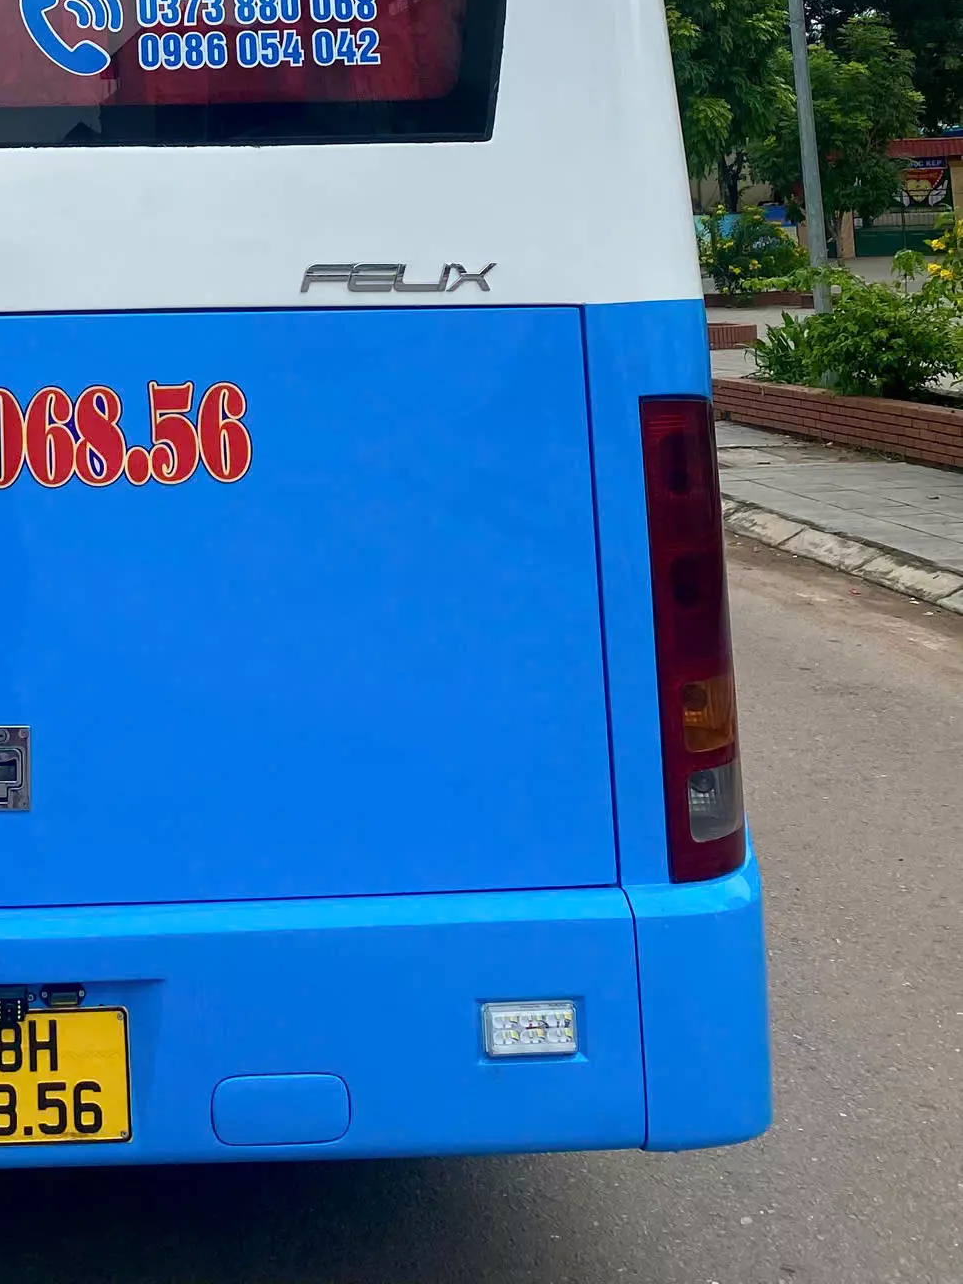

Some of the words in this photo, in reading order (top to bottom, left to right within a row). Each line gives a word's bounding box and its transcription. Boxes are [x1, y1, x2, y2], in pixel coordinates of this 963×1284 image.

[137, 31, 228, 70] 0986
[236, 28, 304, 68] 054
[312, 27, 381, 67] 042
[300, 262, 498, 293] FELIX
